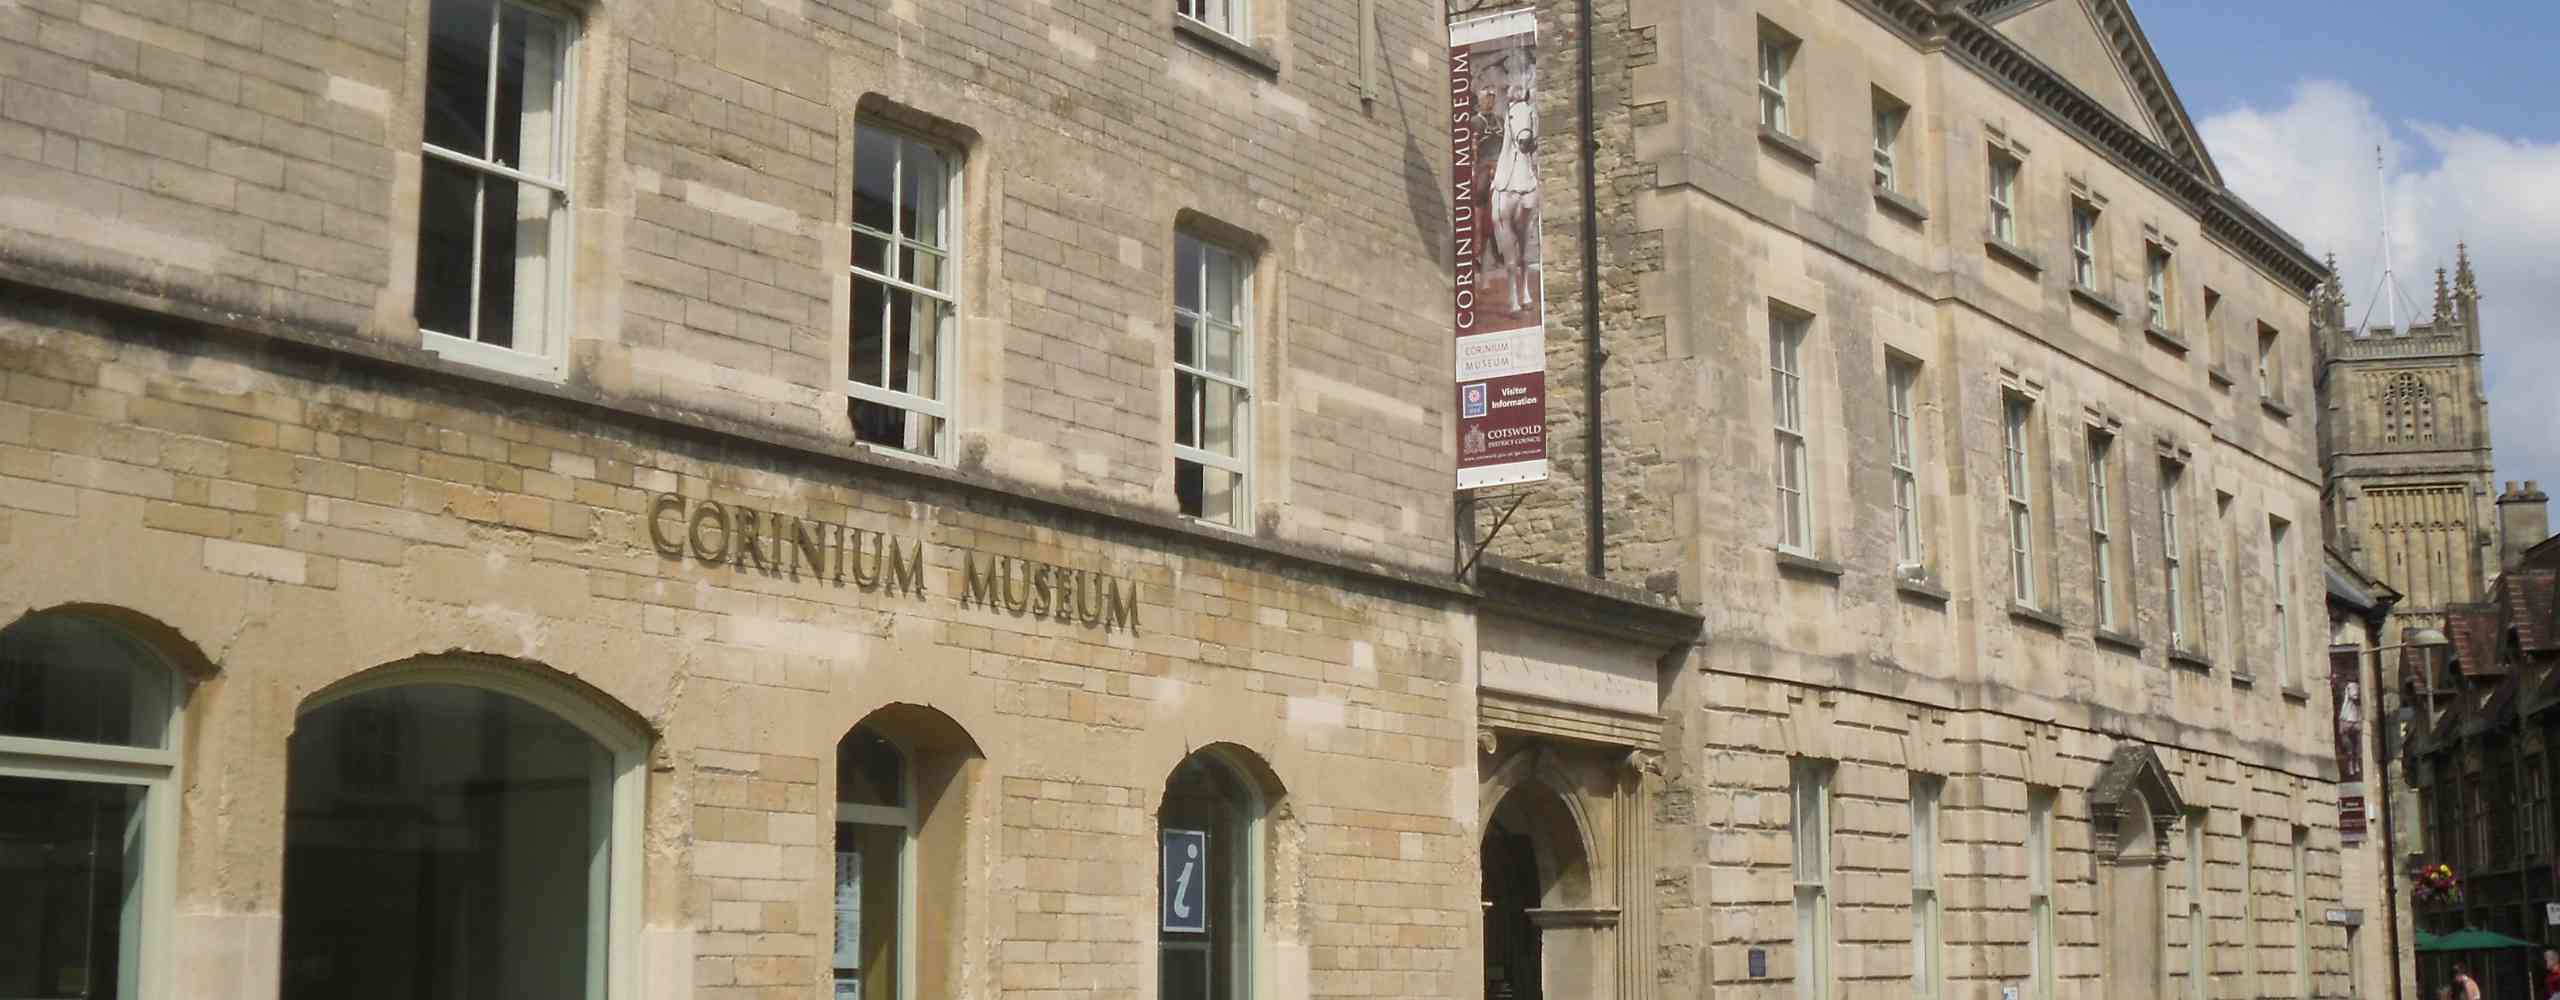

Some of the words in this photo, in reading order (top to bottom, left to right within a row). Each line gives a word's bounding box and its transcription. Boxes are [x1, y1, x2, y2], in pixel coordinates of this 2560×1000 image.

[1452, 52, 1471, 166] MUSEUM
[1455, 179, 1474, 328] CORINIUM
[1465, 343, 1510, 357] CORINIUM
[1465, 357, 1510, 370] MUSEUM
[1502, 387, 1527, 397] Visitor
[1491, 397, 1537, 409] Information
[1487, 425, 1542, 440] COTSWOLD
[648, 493, 926, 601] CORINIUM
[959, 548, 1141, 638] MUSEUM
